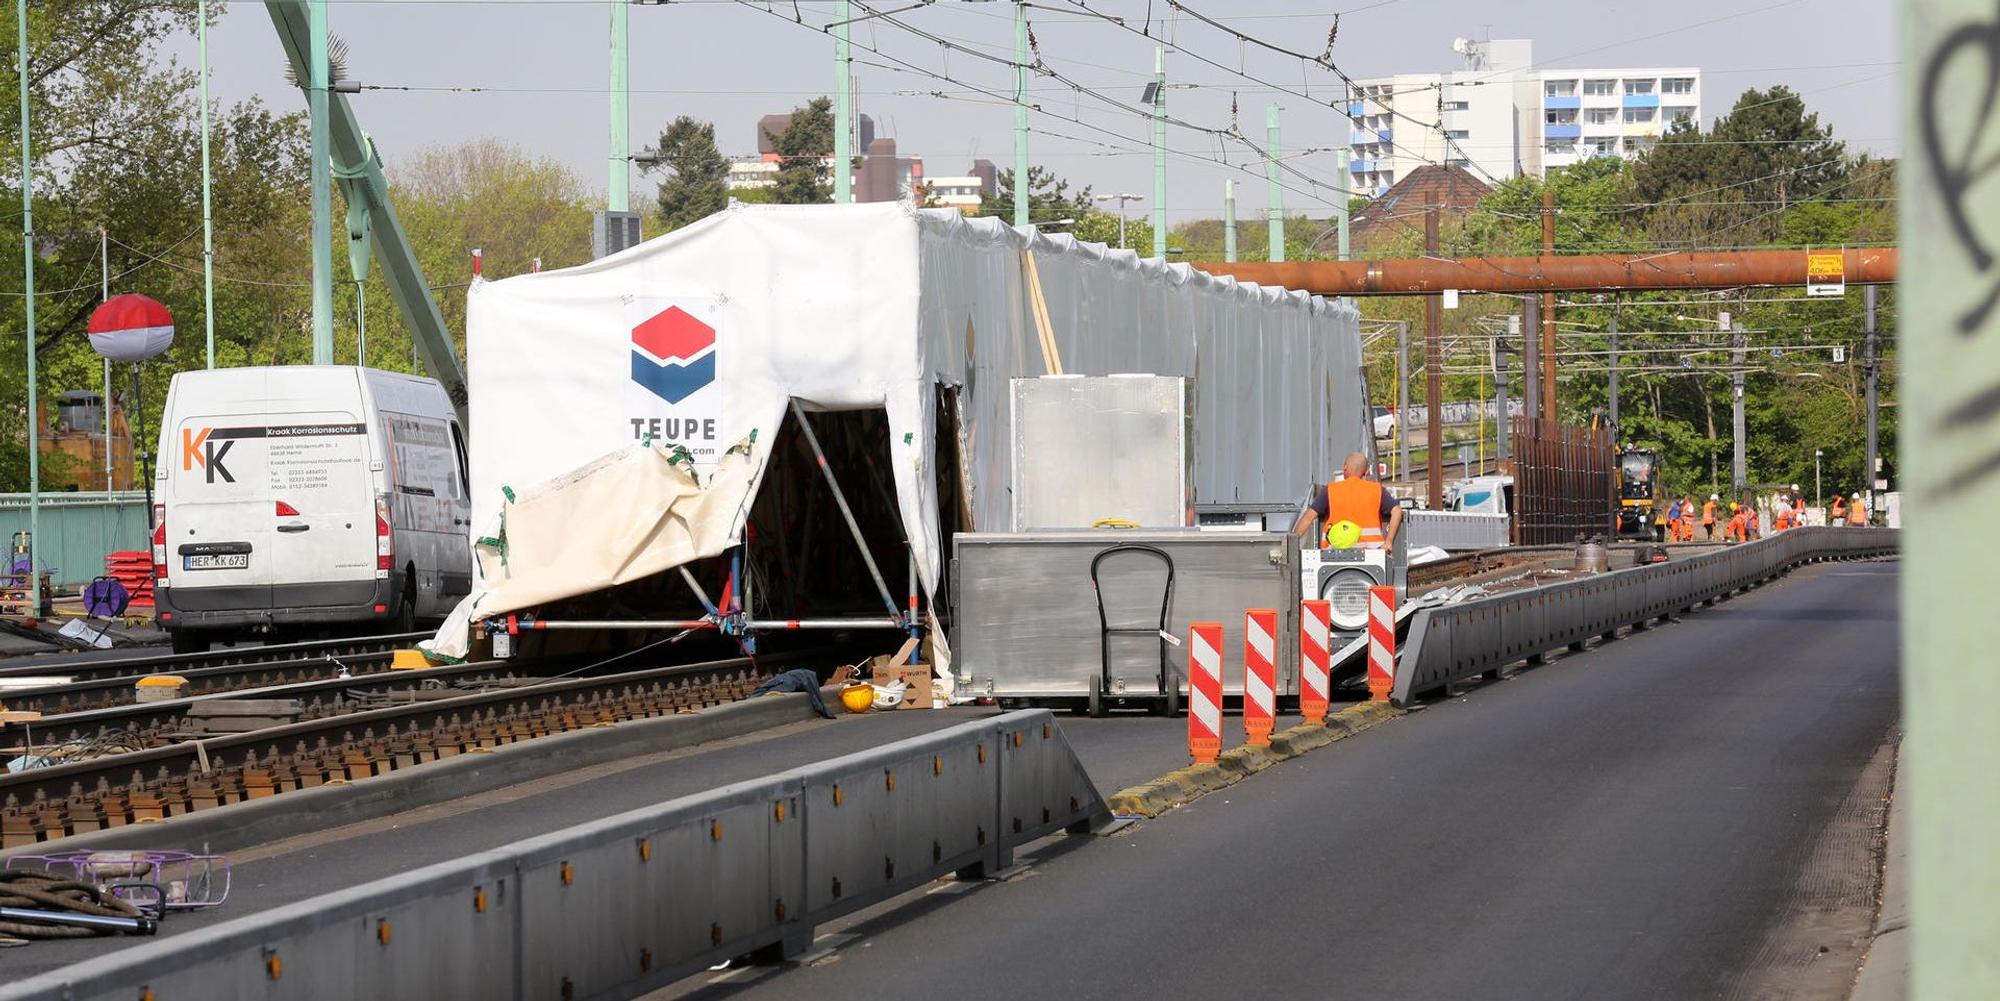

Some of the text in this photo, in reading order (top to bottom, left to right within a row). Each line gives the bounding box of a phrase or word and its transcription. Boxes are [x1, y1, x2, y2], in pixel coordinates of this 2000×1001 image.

[267, 425, 358, 436] Kraak Korrosionsschutz
[630, 417, 716, 440] TEUPE
[191, 555, 246, 567] HER KK 673
